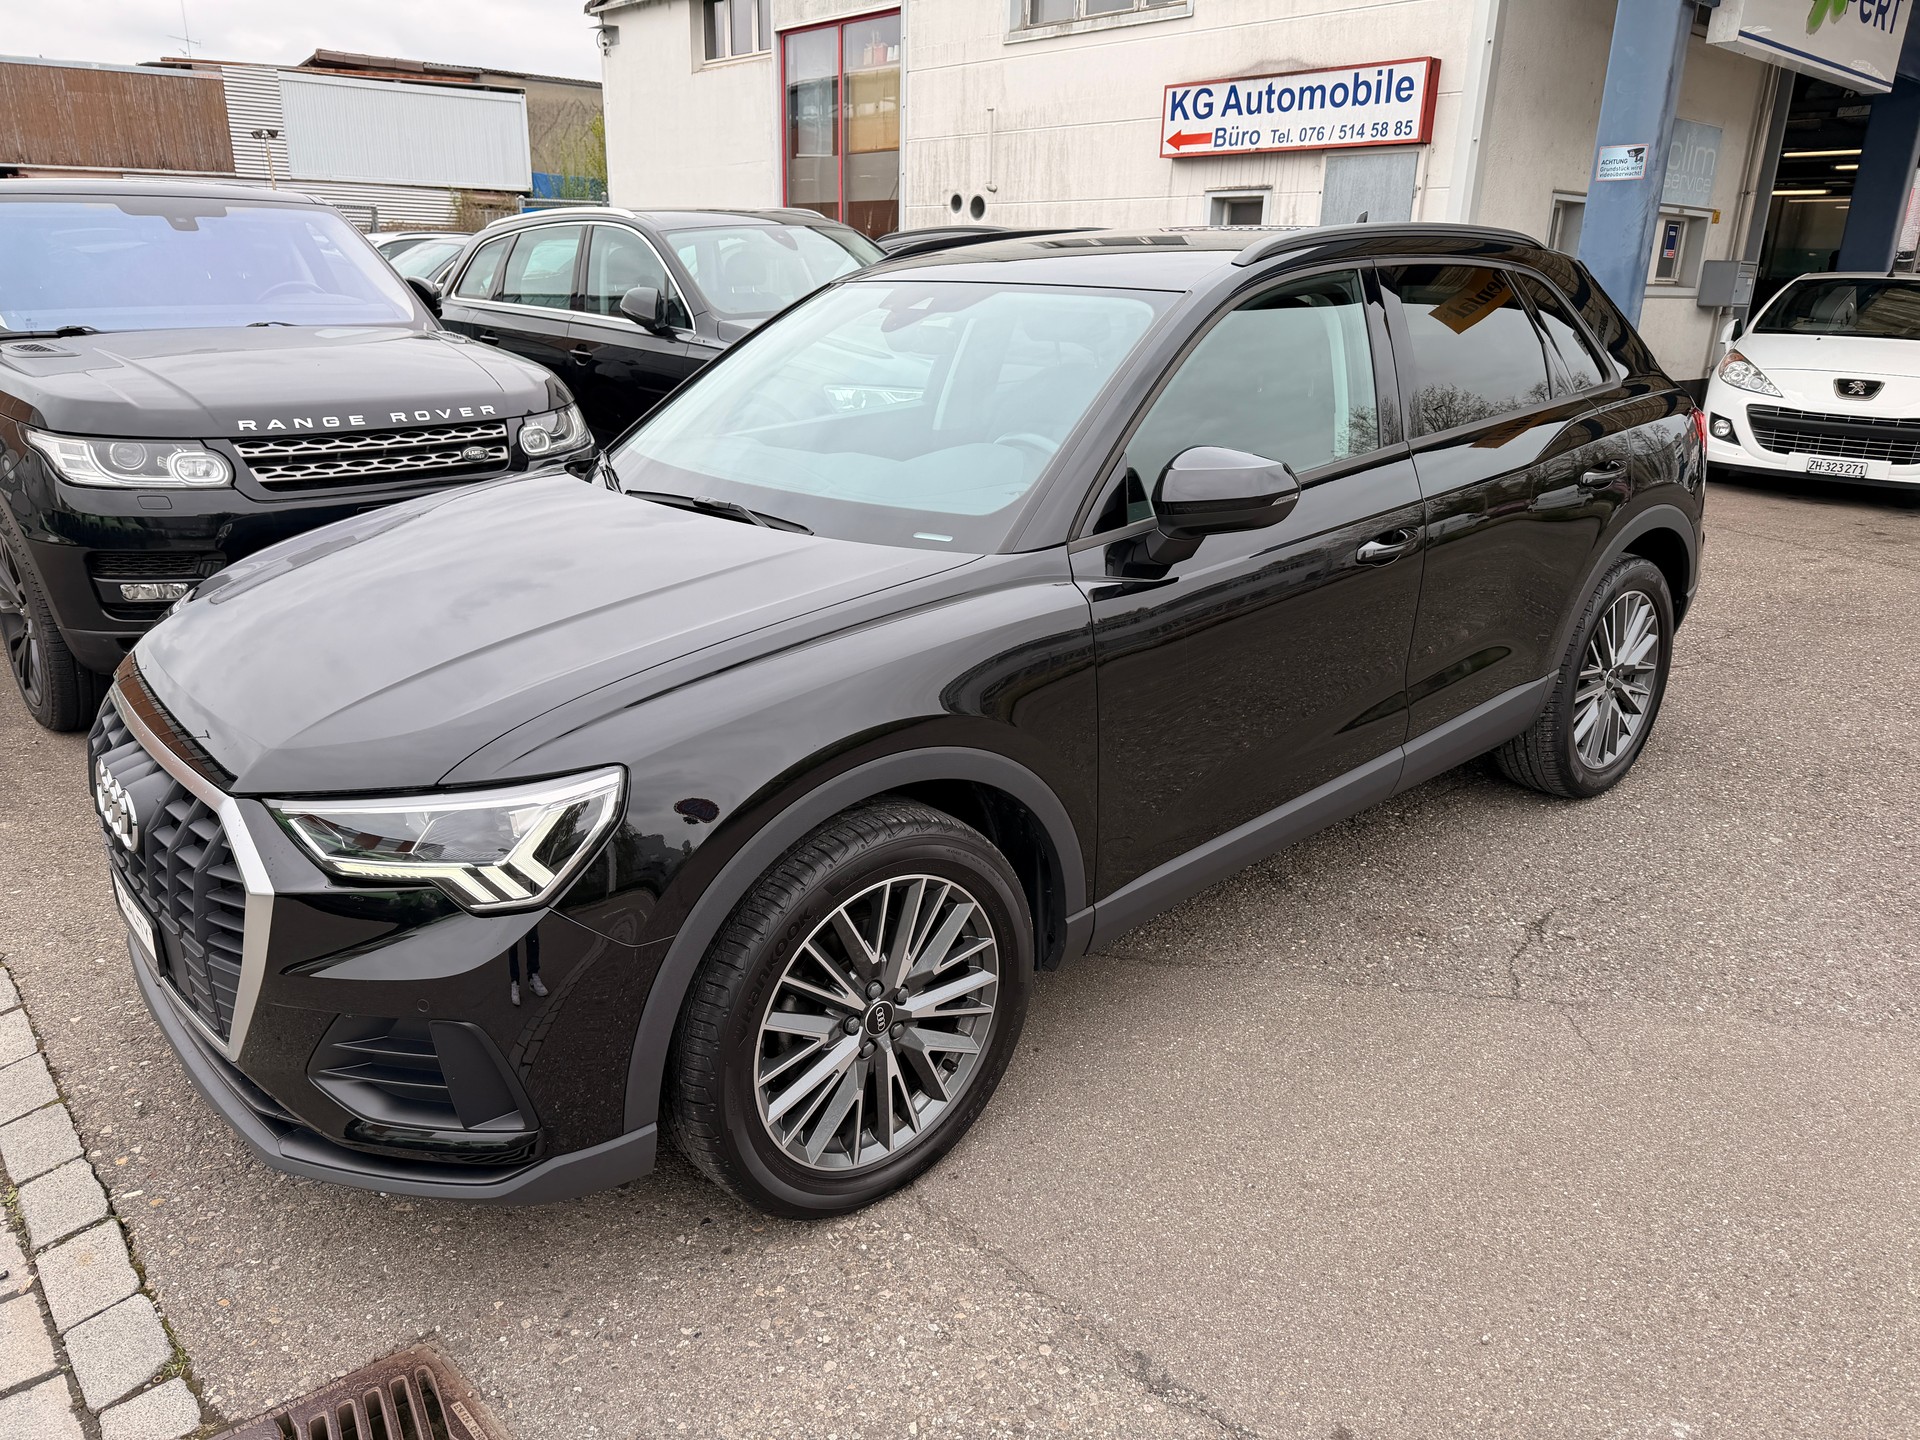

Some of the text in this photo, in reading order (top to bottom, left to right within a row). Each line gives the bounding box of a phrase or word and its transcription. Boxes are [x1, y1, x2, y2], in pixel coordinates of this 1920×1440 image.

[1169, 68, 1415, 122] KG Automobile
[1213, 120, 1413, 148] Büro Tel. 076 / 514 58 85
[1667, 132, 1716, 176] clim
[1664, 172, 1712, 193] service
[237, 405, 497, 431] RANGE ROVER
